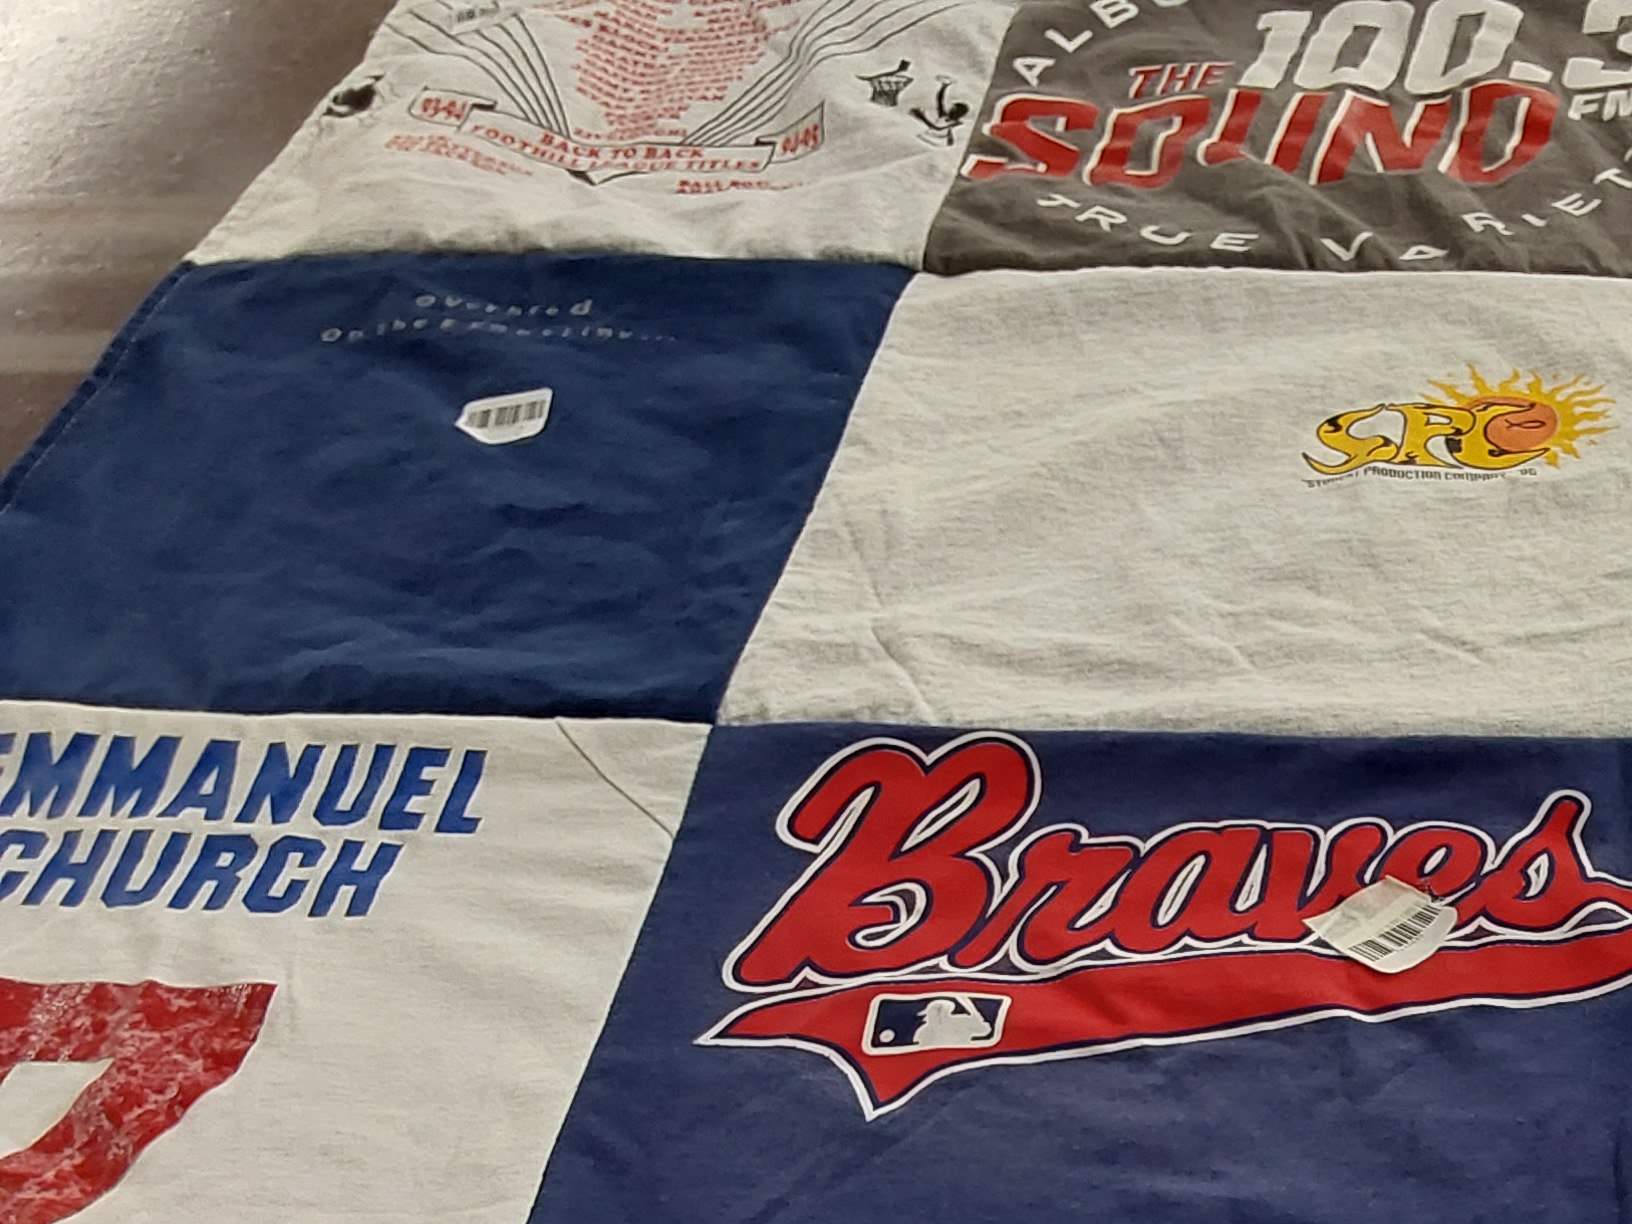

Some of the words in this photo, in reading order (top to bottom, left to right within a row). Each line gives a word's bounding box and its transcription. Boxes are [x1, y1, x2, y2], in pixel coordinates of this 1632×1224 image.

[1127, 61, 1236, 99] THE
[540, 133, 600, 158] BACK
[611, 147, 637, 159] TO
[643, 146, 704, 159] BACK
[960, 80, 1561, 188] SOUND
[1037, 193, 1260, 253] TRUE
[0, 731, 489, 836] MMANUEL
